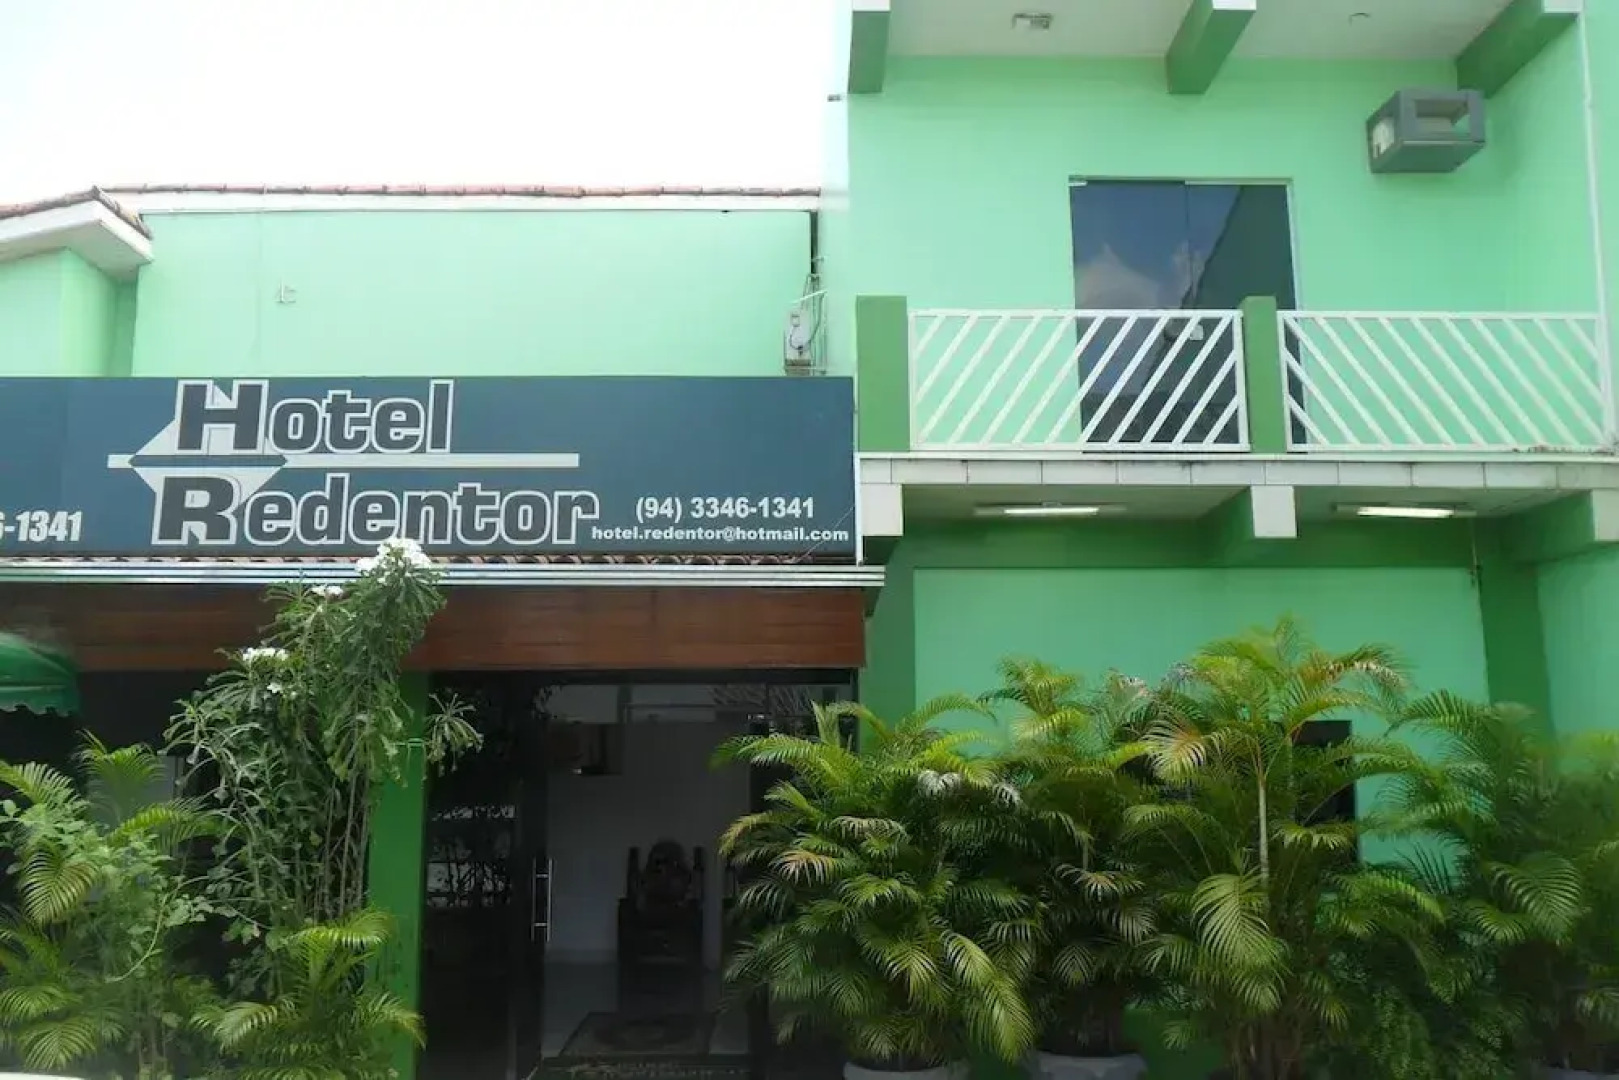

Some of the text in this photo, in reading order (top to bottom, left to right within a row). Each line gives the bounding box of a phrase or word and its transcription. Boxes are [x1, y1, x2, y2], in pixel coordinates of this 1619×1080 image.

[176, 380, 454, 454] Hotel
[152, 472, 600, 545] Redentor
[591, 525, 849, 542] hotel.redentor@hotmail.com
[635, 496, 815, 523] (94) 3346-1341
